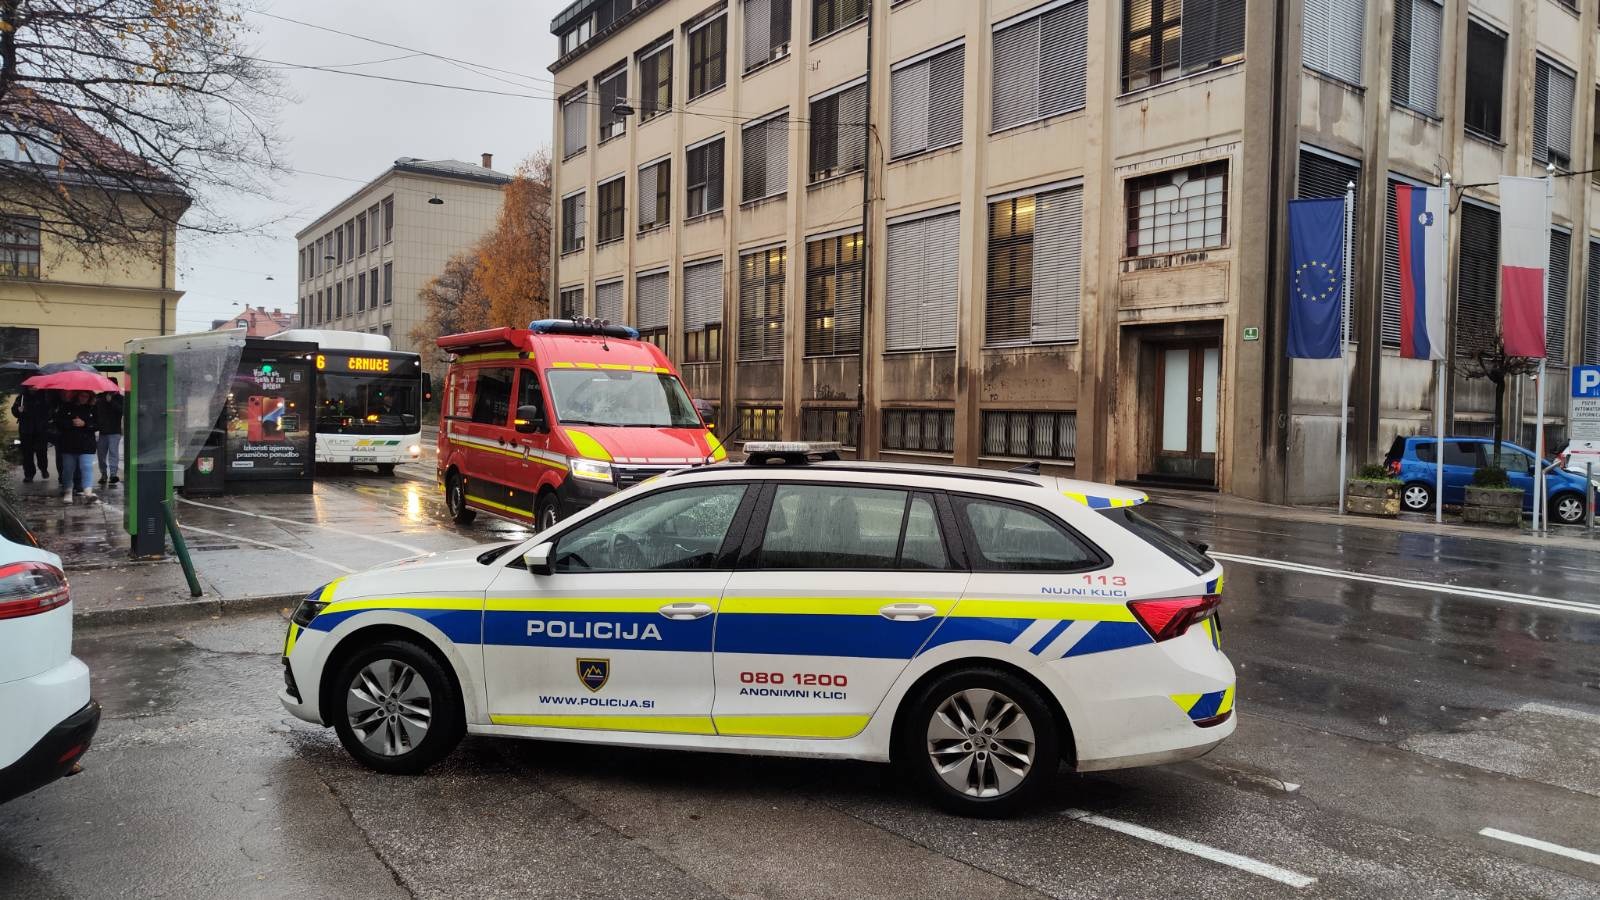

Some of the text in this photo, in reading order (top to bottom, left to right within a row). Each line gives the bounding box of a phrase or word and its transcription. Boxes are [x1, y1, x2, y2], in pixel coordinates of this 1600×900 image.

[316, 355, 389, 371] 6 ČRNUČE
[1580, 370, 1600, 394] P
[1082, 575, 1127, 586] 113
[1041, 587, 1127, 597] NUJNI KLICI
[526, 620, 663, 641] POLICIJA
[740, 672, 848, 687] 080 1200
[740, 688, 847, 700] ANONIMNI KLICI
[538, 695, 655, 709] WWW.POLICIJA.SI
